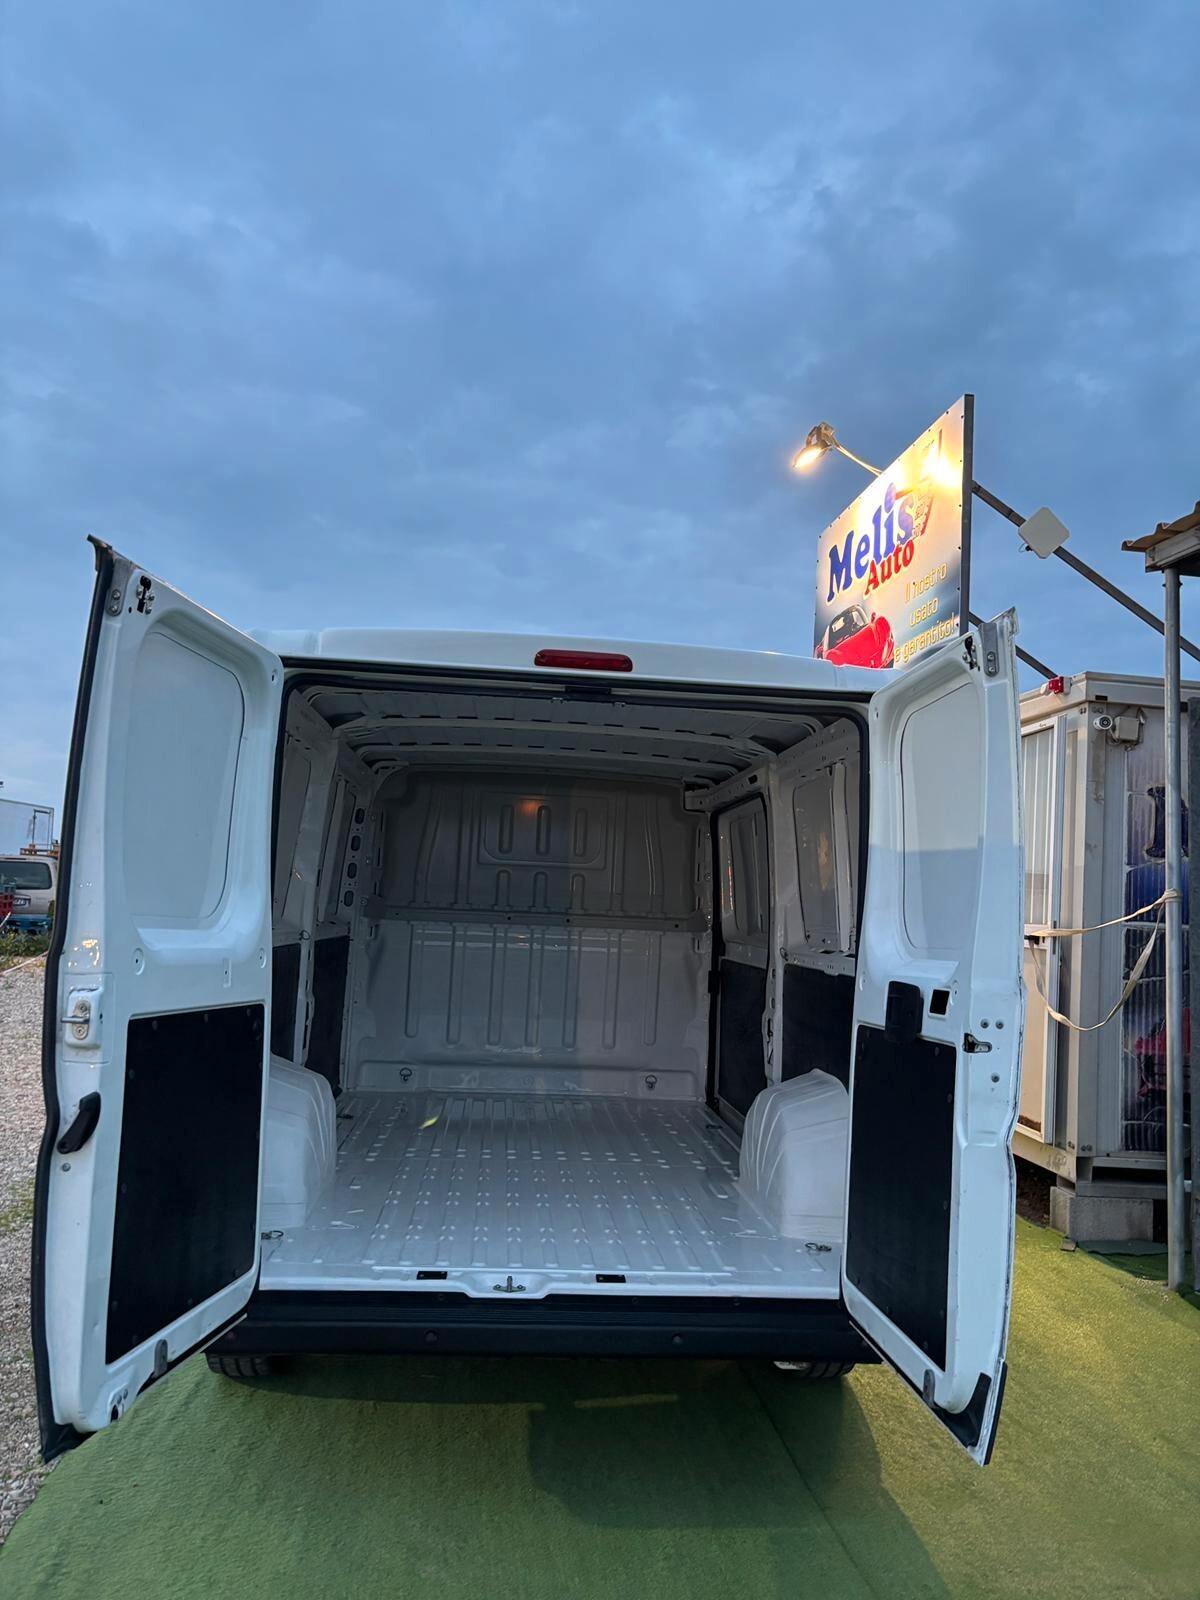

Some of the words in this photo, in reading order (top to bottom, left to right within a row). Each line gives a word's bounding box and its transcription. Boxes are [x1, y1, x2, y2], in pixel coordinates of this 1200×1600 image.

[827, 482, 914, 602] Melis
[865, 540, 914, 595] Auto
[913, 563, 947, 598] nostro
[894, 648, 901, 663] e
[903, 612, 955, 664] garantito!
[910, 598, 938, 628] usato
